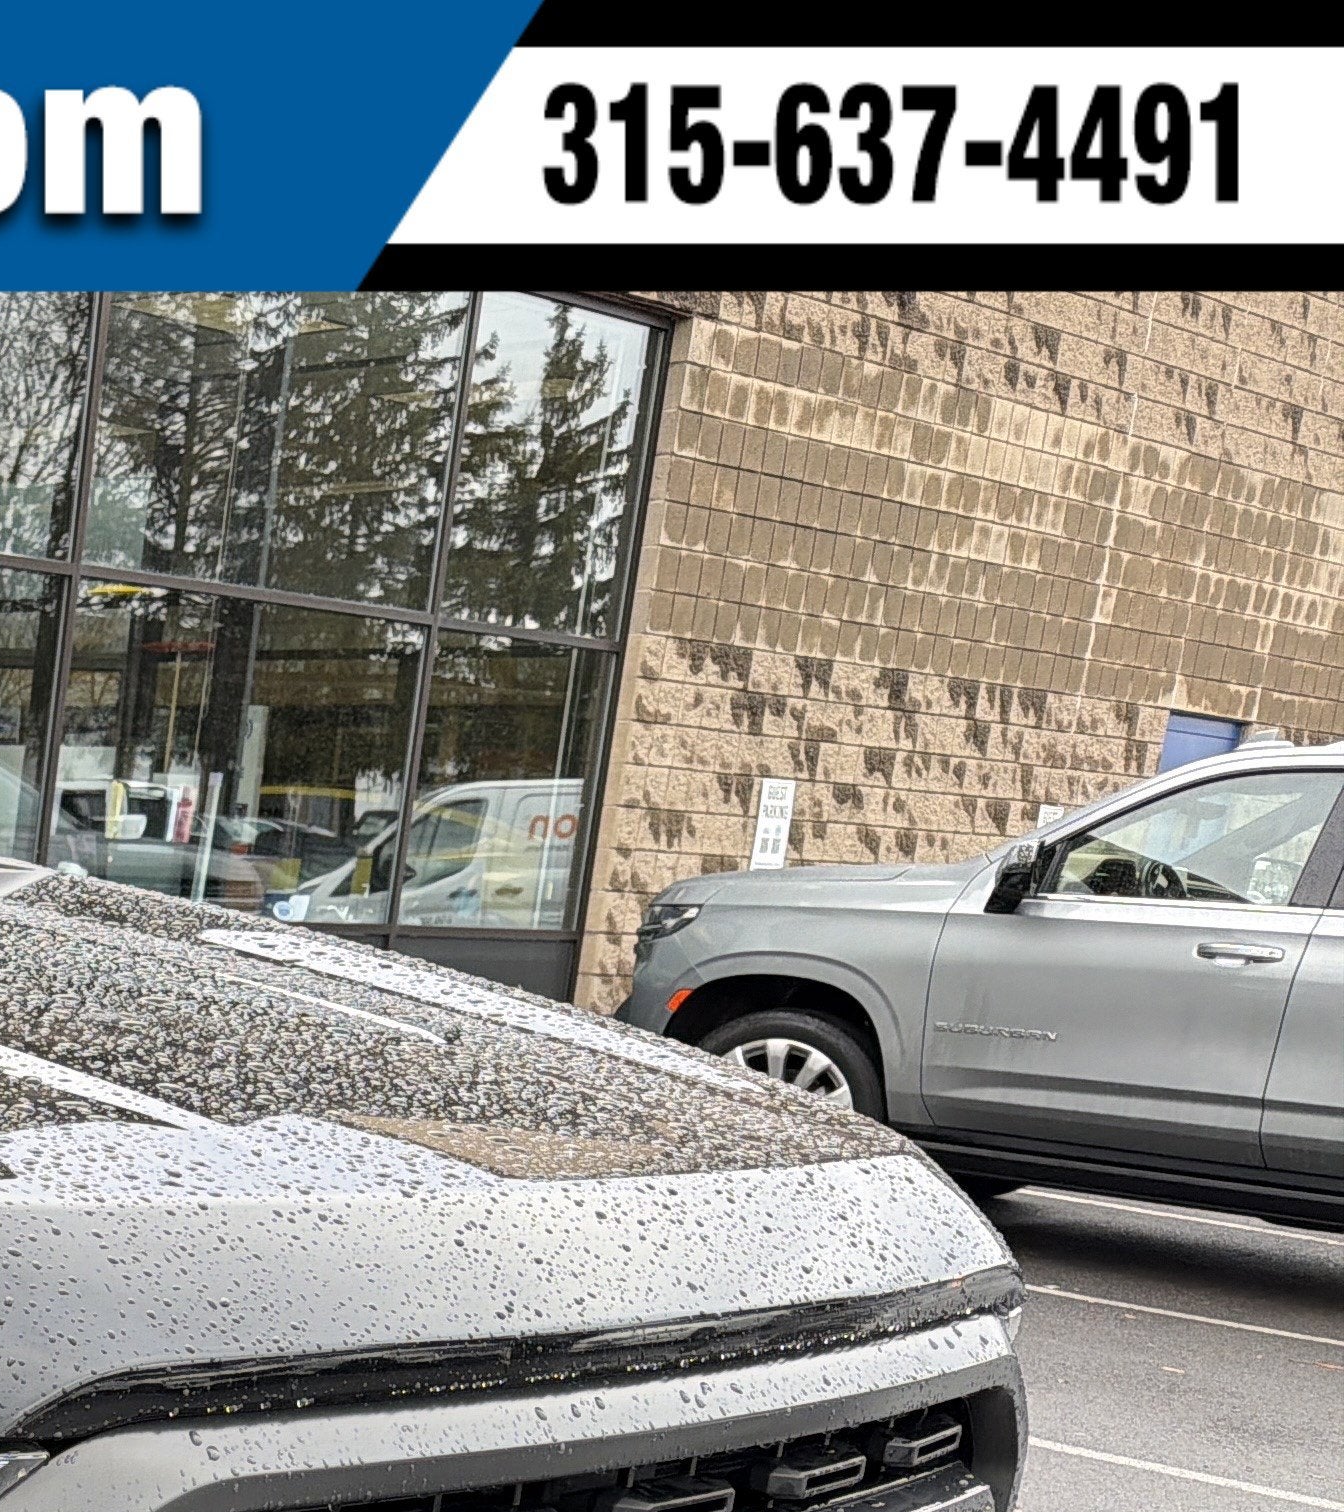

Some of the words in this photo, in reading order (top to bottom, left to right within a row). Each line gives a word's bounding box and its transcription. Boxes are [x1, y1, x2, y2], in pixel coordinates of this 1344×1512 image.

[768, 785, 788, 801] GUEST
[762, 804, 789, 820] PARKING
[934, 1021, 1058, 1042] SUBURBAN
